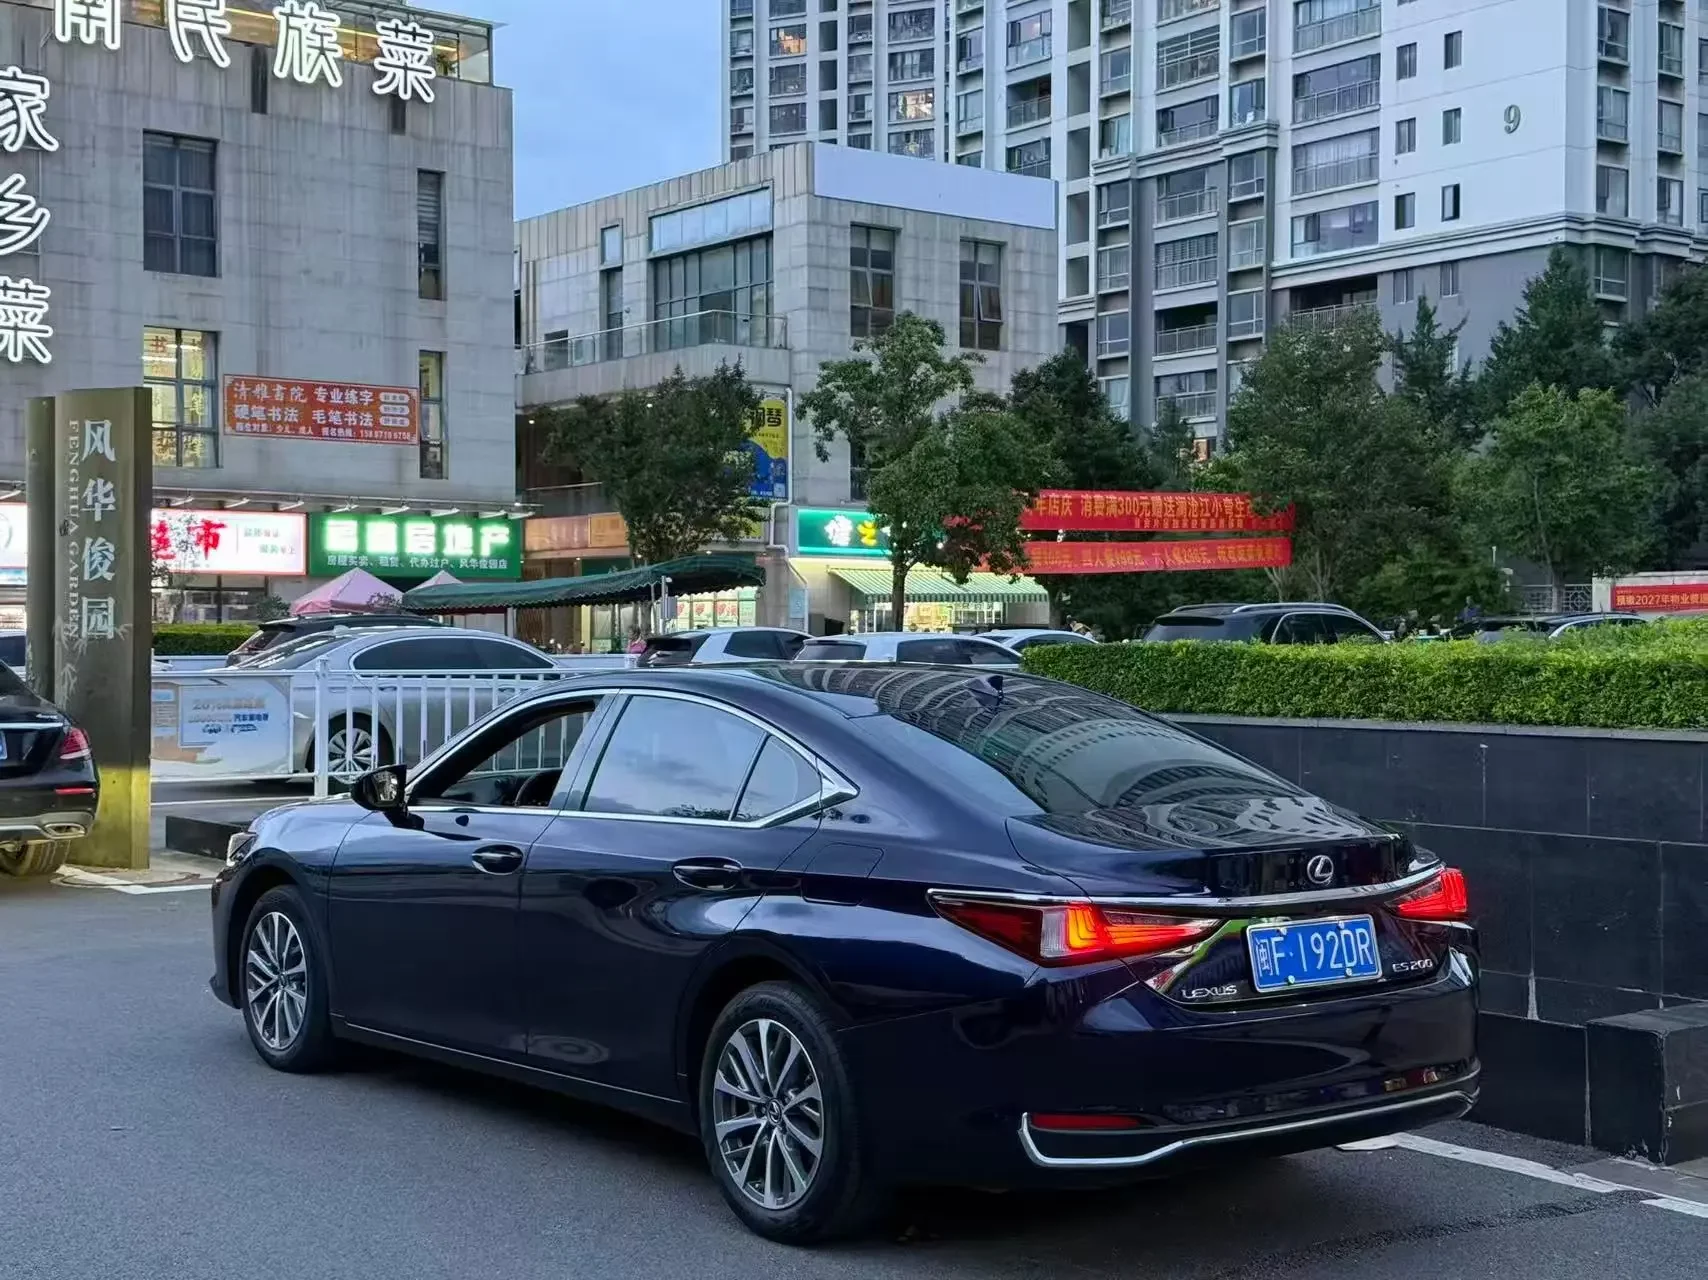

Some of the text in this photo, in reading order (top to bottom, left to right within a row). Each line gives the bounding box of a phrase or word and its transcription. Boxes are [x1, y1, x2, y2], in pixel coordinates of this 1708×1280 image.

[1503, 104, 1521, 134] 9
[314, 387, 374, 406] 专业练字
[234, 404, 299, 423] 硬笔书法
[312, 409, 374, 427] 毛笔书法
[67, 420, 80, 638] FENGHUA GARDEN
[80, 419, 117, 640] 风华俊园
[1181, 984, 1238, 999] LEXUS
